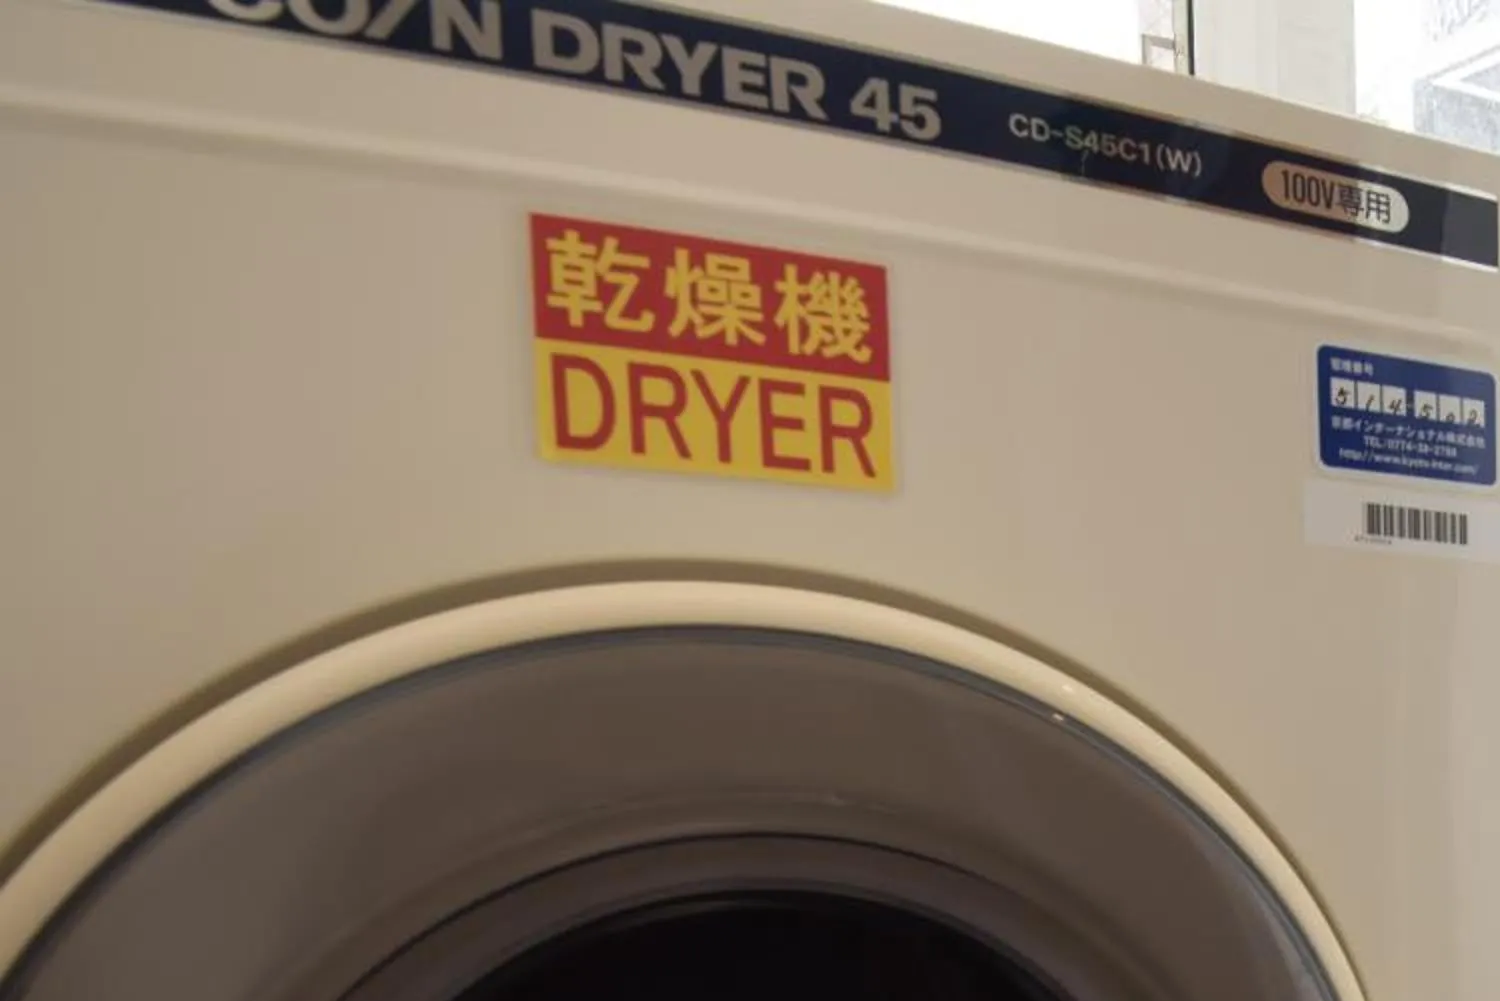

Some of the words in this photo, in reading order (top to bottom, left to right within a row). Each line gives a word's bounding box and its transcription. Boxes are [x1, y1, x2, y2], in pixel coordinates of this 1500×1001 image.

[531, 9, 830, 121] DRYER
[849, 77, 942, 142] 45
[1008, 113, 1203, 177] CD-S45C1(W)
[1281, 169, 1392, 224] 100V専用
[546, 230, 874, 364] 乾燥機
[550, 353, 878, 479] DRYER
